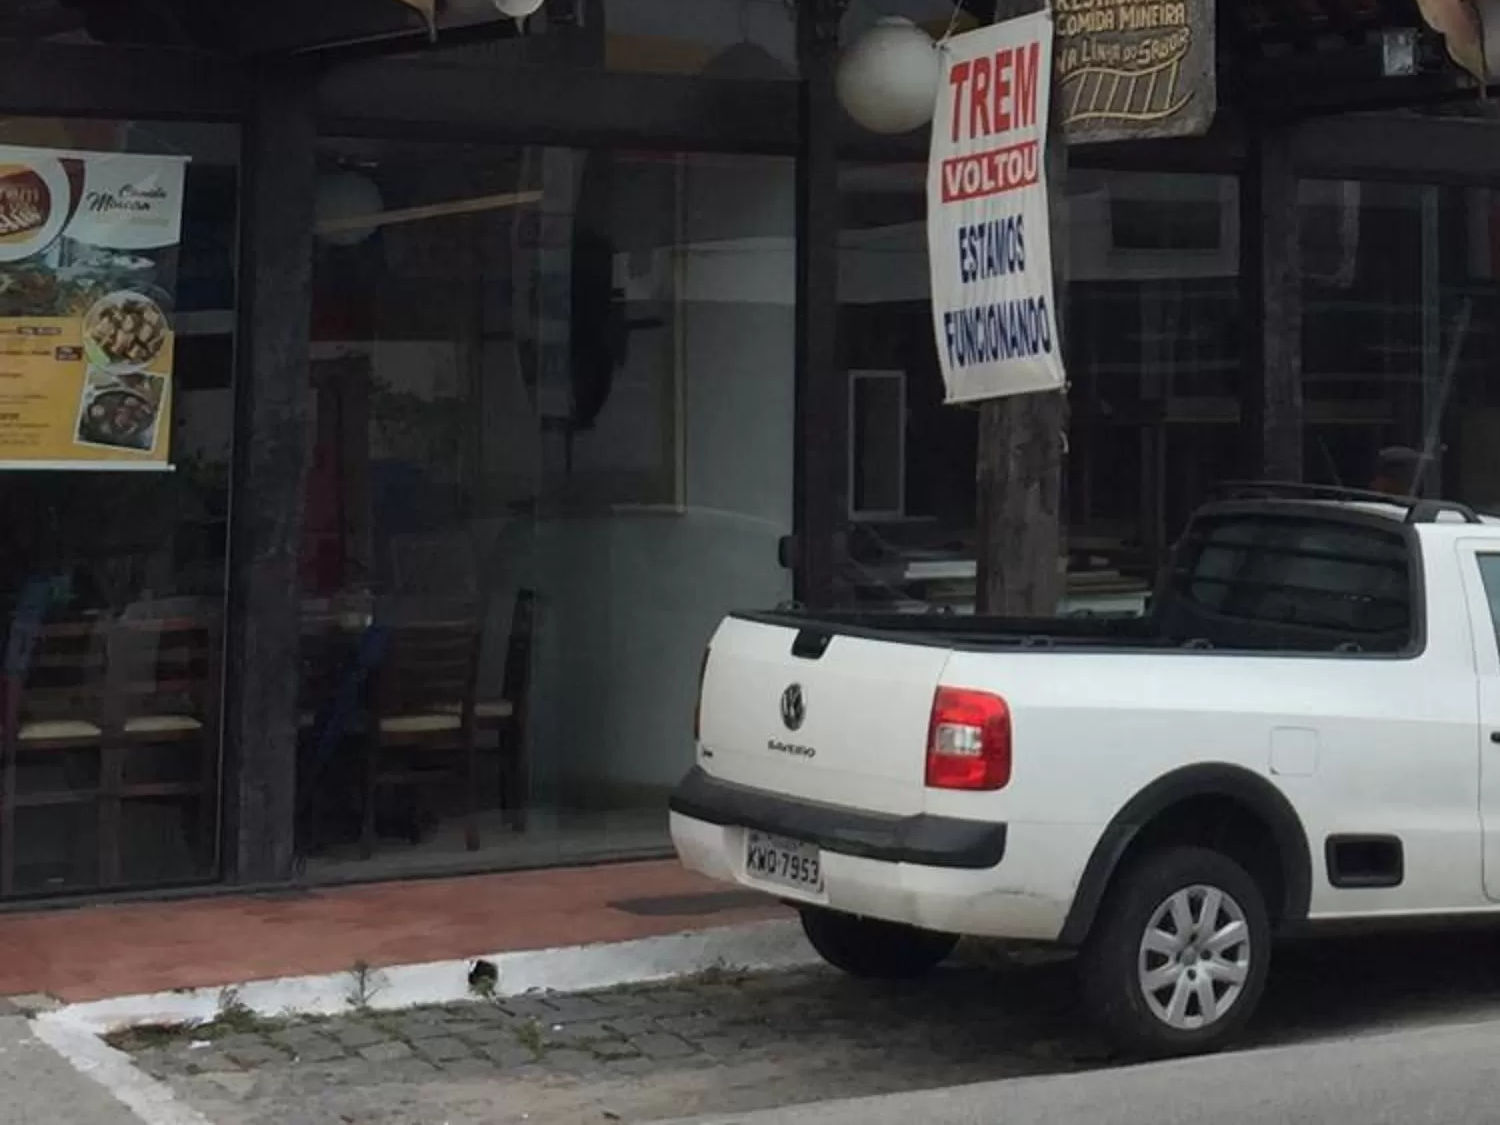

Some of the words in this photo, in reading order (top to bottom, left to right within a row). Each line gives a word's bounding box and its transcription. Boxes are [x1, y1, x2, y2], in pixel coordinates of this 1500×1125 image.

[1057, 6, 1113, 36] COMIDA
[1119, 2, 1186, 29] MINEIRA
[949, 42, 1040, 143] TREM
[945, 146, 1038, 197] VOLTOU
[958, 214, 1026, 284] ESTAMOS
[944, 294, 1052, 372] FUNCIONANDO
